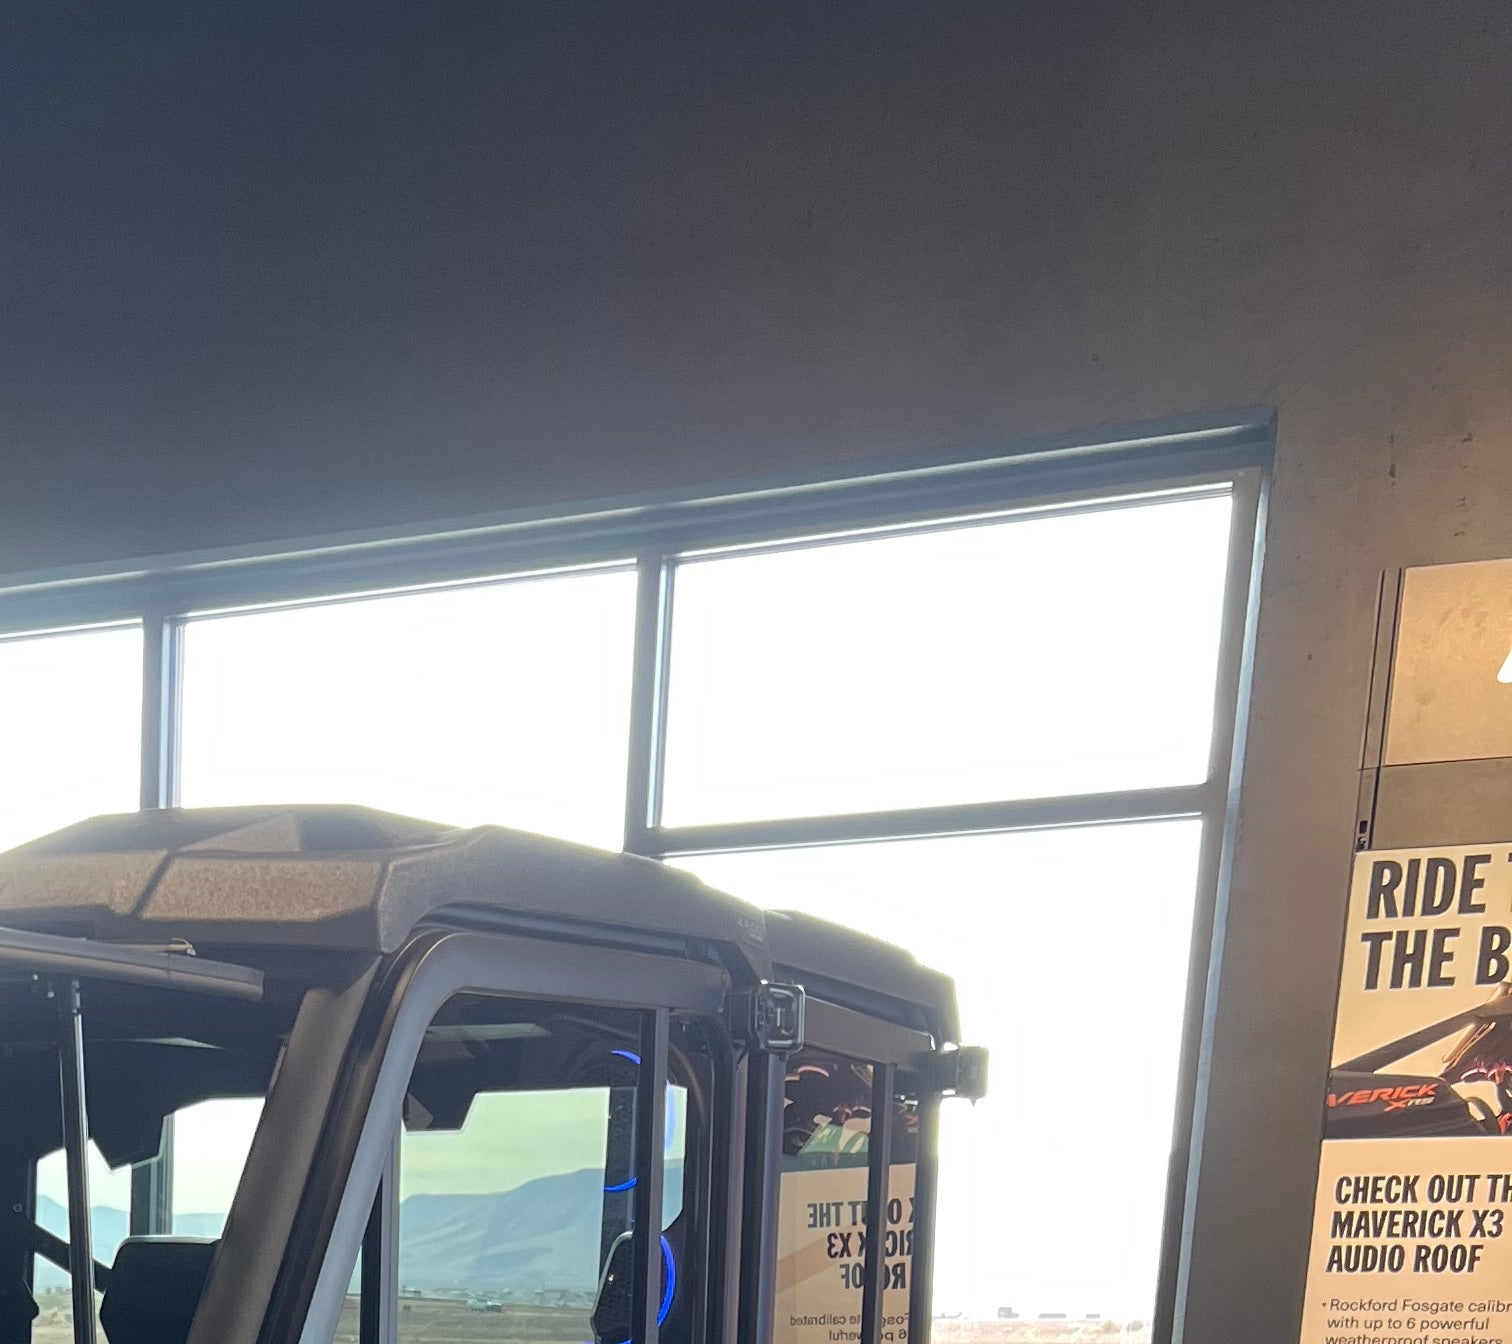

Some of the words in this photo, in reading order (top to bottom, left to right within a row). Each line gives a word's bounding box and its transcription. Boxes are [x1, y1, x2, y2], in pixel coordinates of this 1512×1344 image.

[1366, 854, 1492, 919] RIDE
[1361, 928, 1460, 990] THE
[1335, 1175, 1420, 1204] CHECK
[1427, 1174, 1481, 1203] OUT
[1330, 1210, 1464, 1238] MAVERICK
[1469, 1209, 1504, 1238] X3
[1326, 1244, 1406, 1273] AUDIO
[1413, 1244, 1484, 1273] ROOF
[1329, 1298, 1397, 1313] Rockford
[1401, 1298, 1464, 1315] Fosgate
[1327, 1316, 1359, 1330] with
[1364, 1320, 1383, 1332] up
[1387, 1318, 1402, 1330] to
[1406, 1317, 1416, 1330] 6
[1420, 1317, 1489, 1332] powerful
